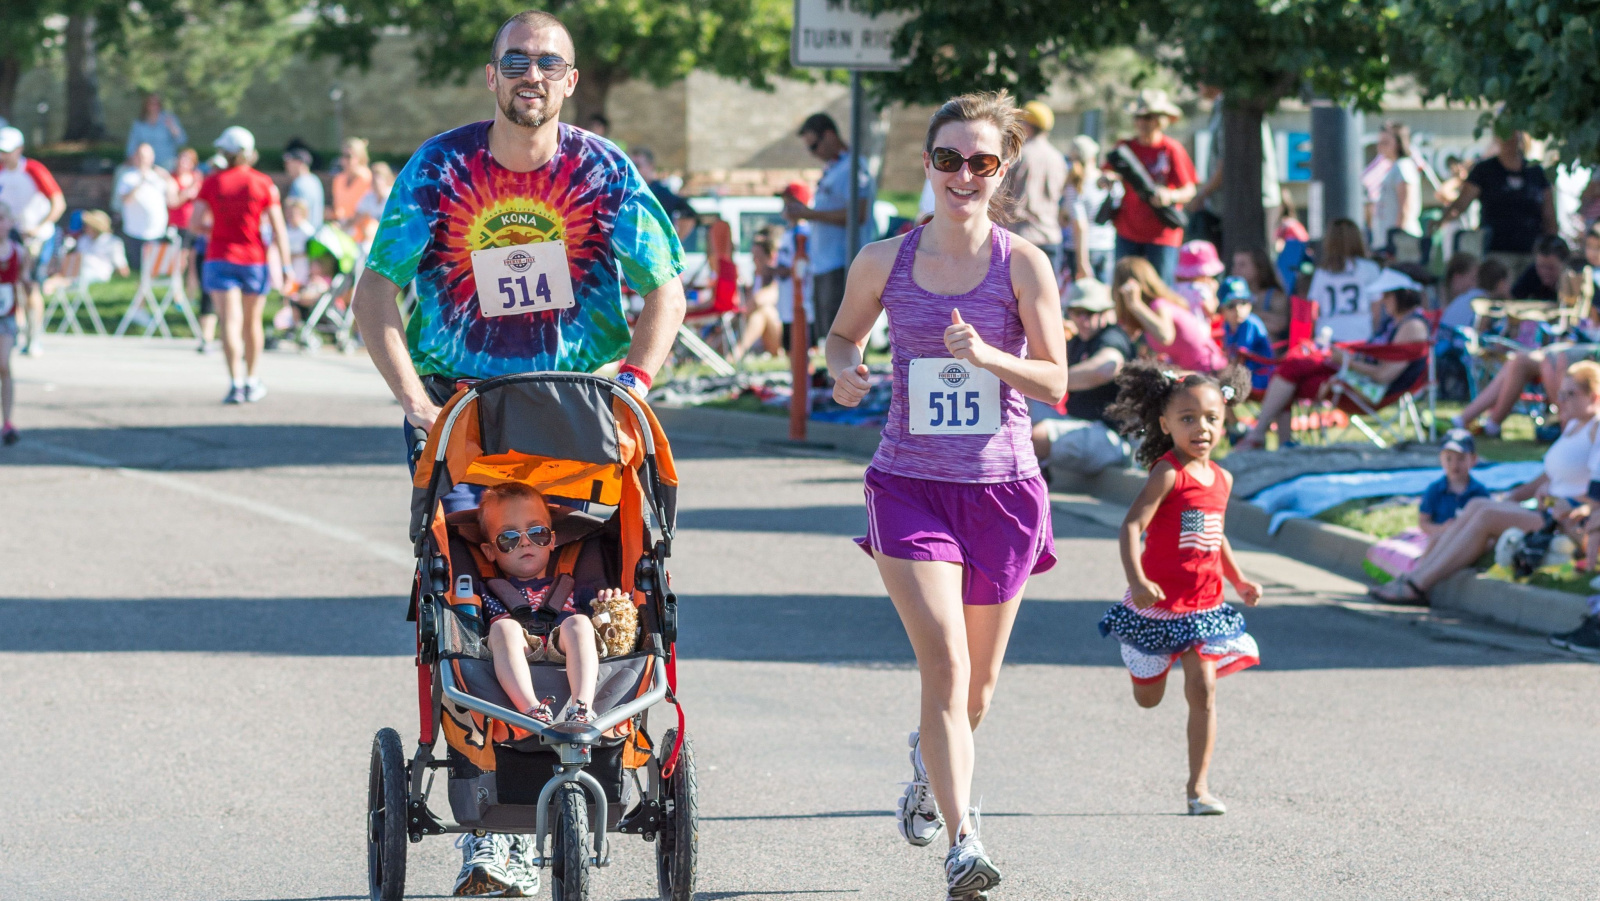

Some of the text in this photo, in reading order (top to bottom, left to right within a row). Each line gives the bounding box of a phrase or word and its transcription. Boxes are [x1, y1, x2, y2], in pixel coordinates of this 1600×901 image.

[802, 28, 895, 50] TURN RIG
[501, 213, 537, 226] KONA
[498, 273, 551, 309] 514
[1326, 284, 1359, 317] 13
[929, 391, 980, 427] 515
